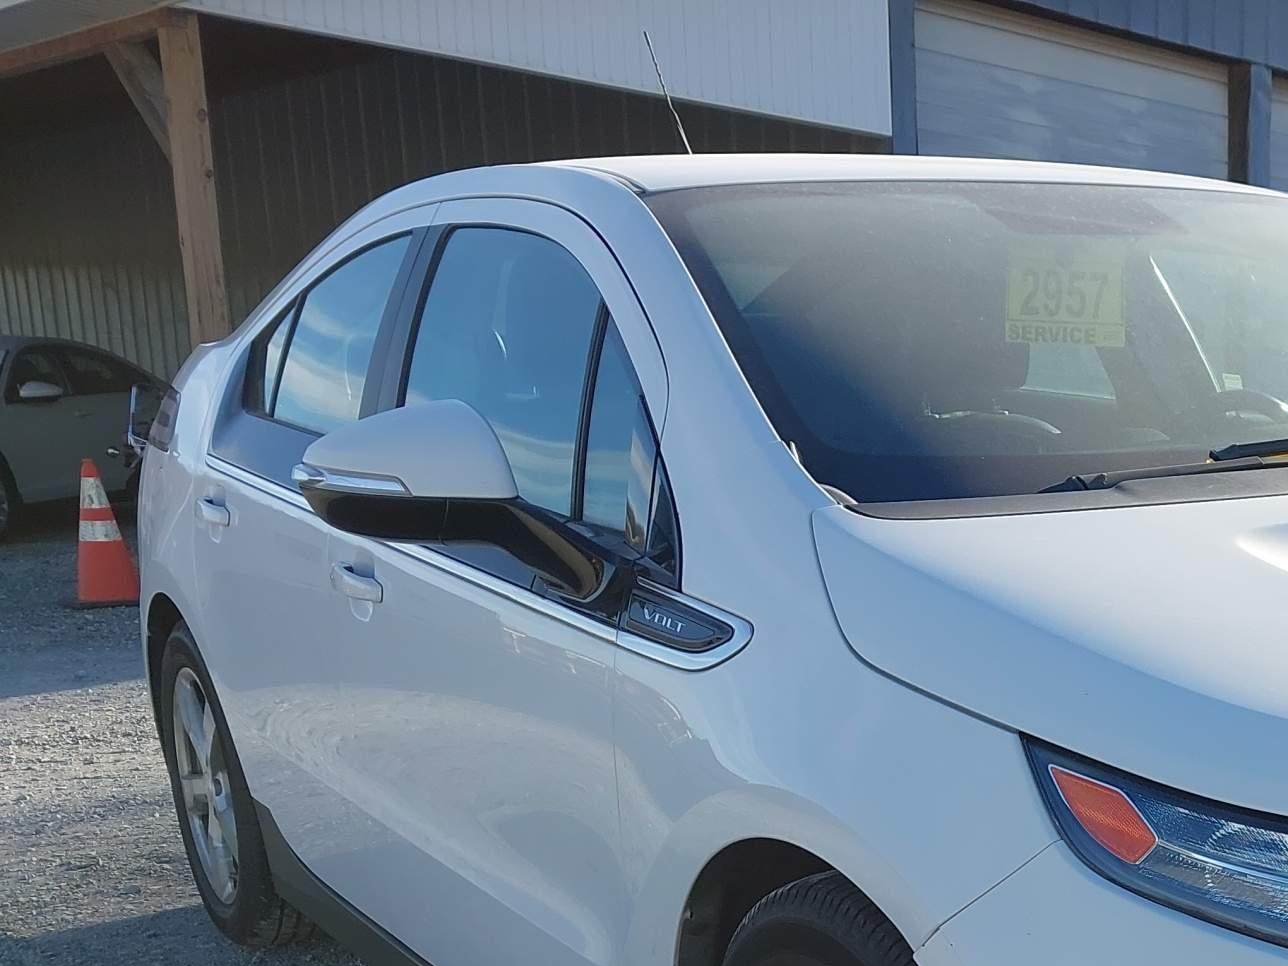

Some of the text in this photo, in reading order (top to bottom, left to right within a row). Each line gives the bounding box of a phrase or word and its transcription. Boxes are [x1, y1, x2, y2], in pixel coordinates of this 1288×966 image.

[1019, 266, 1109, 320] 2957
[1007, 323, 1097, 345] SERVICE
[643, 605, 687, 633] VOLT
